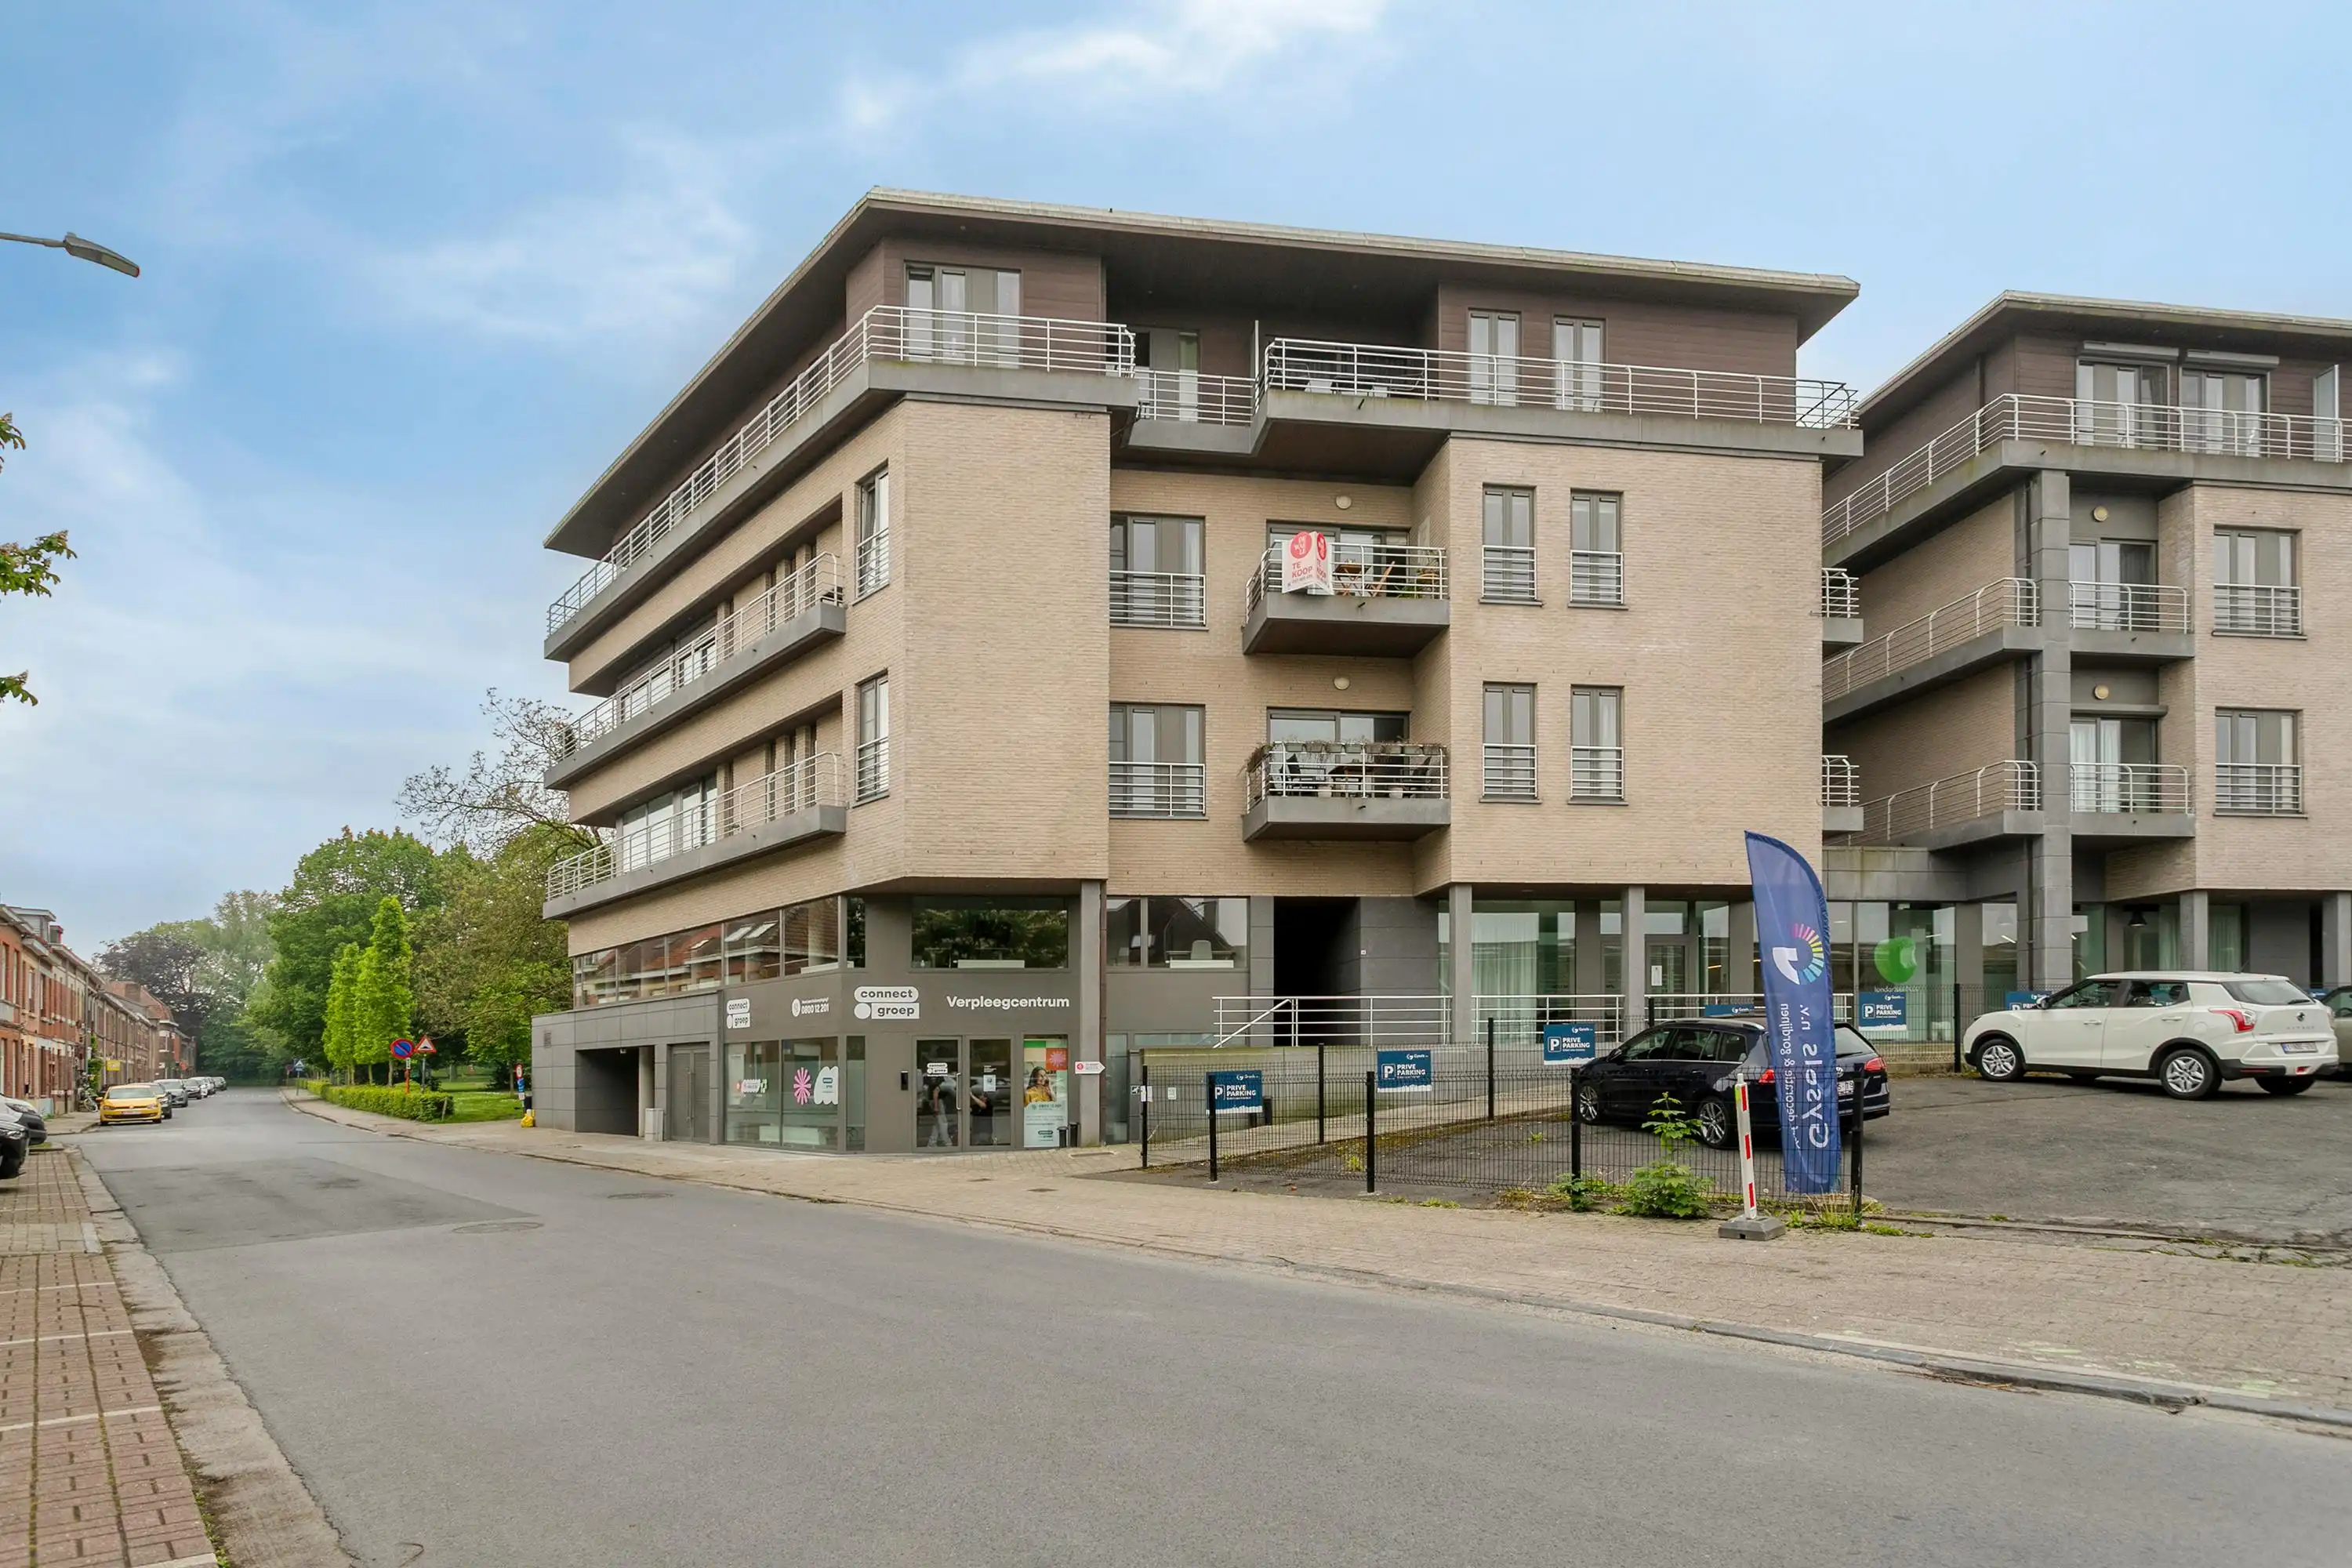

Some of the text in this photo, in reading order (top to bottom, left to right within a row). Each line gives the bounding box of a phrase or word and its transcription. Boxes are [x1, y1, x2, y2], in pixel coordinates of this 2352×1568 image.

[1292, 566, 1312, 578] KOOP
[861, 989, 913, 998] connect
[946, 996, 1069, 1010] Verpleegcentrum
[877, 1006, 915, 1018] groep
[1864, 1006, 1874, 1018] P
[1550, 1039, 1560, 1051] P
[1384, 1065, 1394, 1078] P
[1215, 1087, 1223, 1099] P
